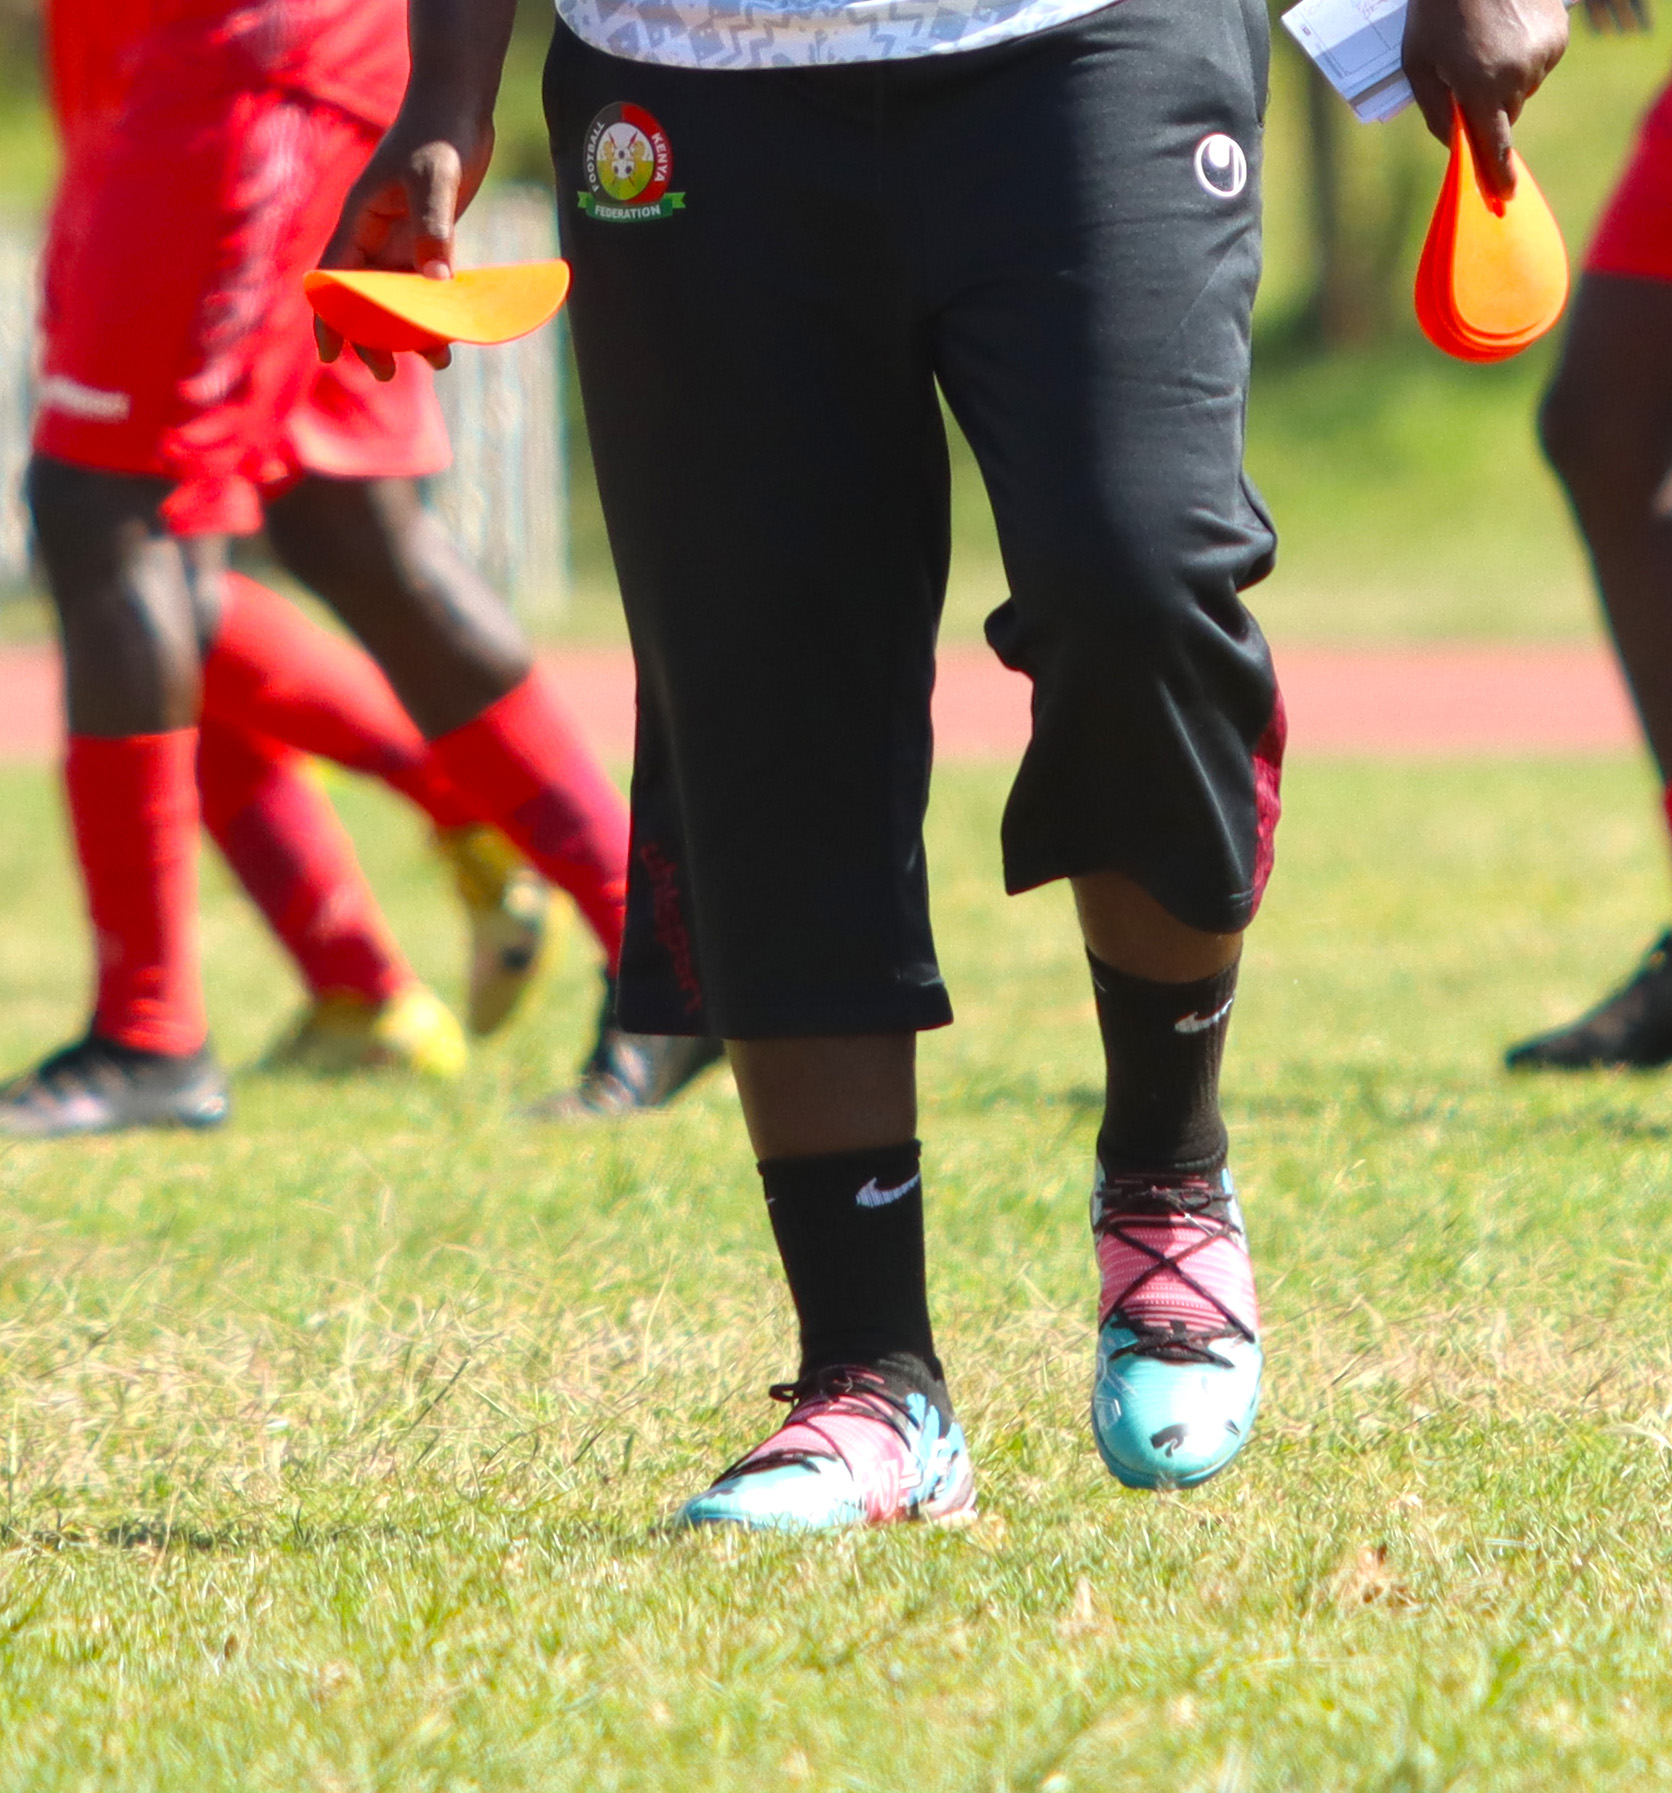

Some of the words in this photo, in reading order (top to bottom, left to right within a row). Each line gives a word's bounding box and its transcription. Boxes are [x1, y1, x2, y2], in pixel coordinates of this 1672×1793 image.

[586, 120, 606, 193] FOOTBALL
[651, 131, 669, 183] KENYA
[594, 204, 661, 219] FEDERATION
